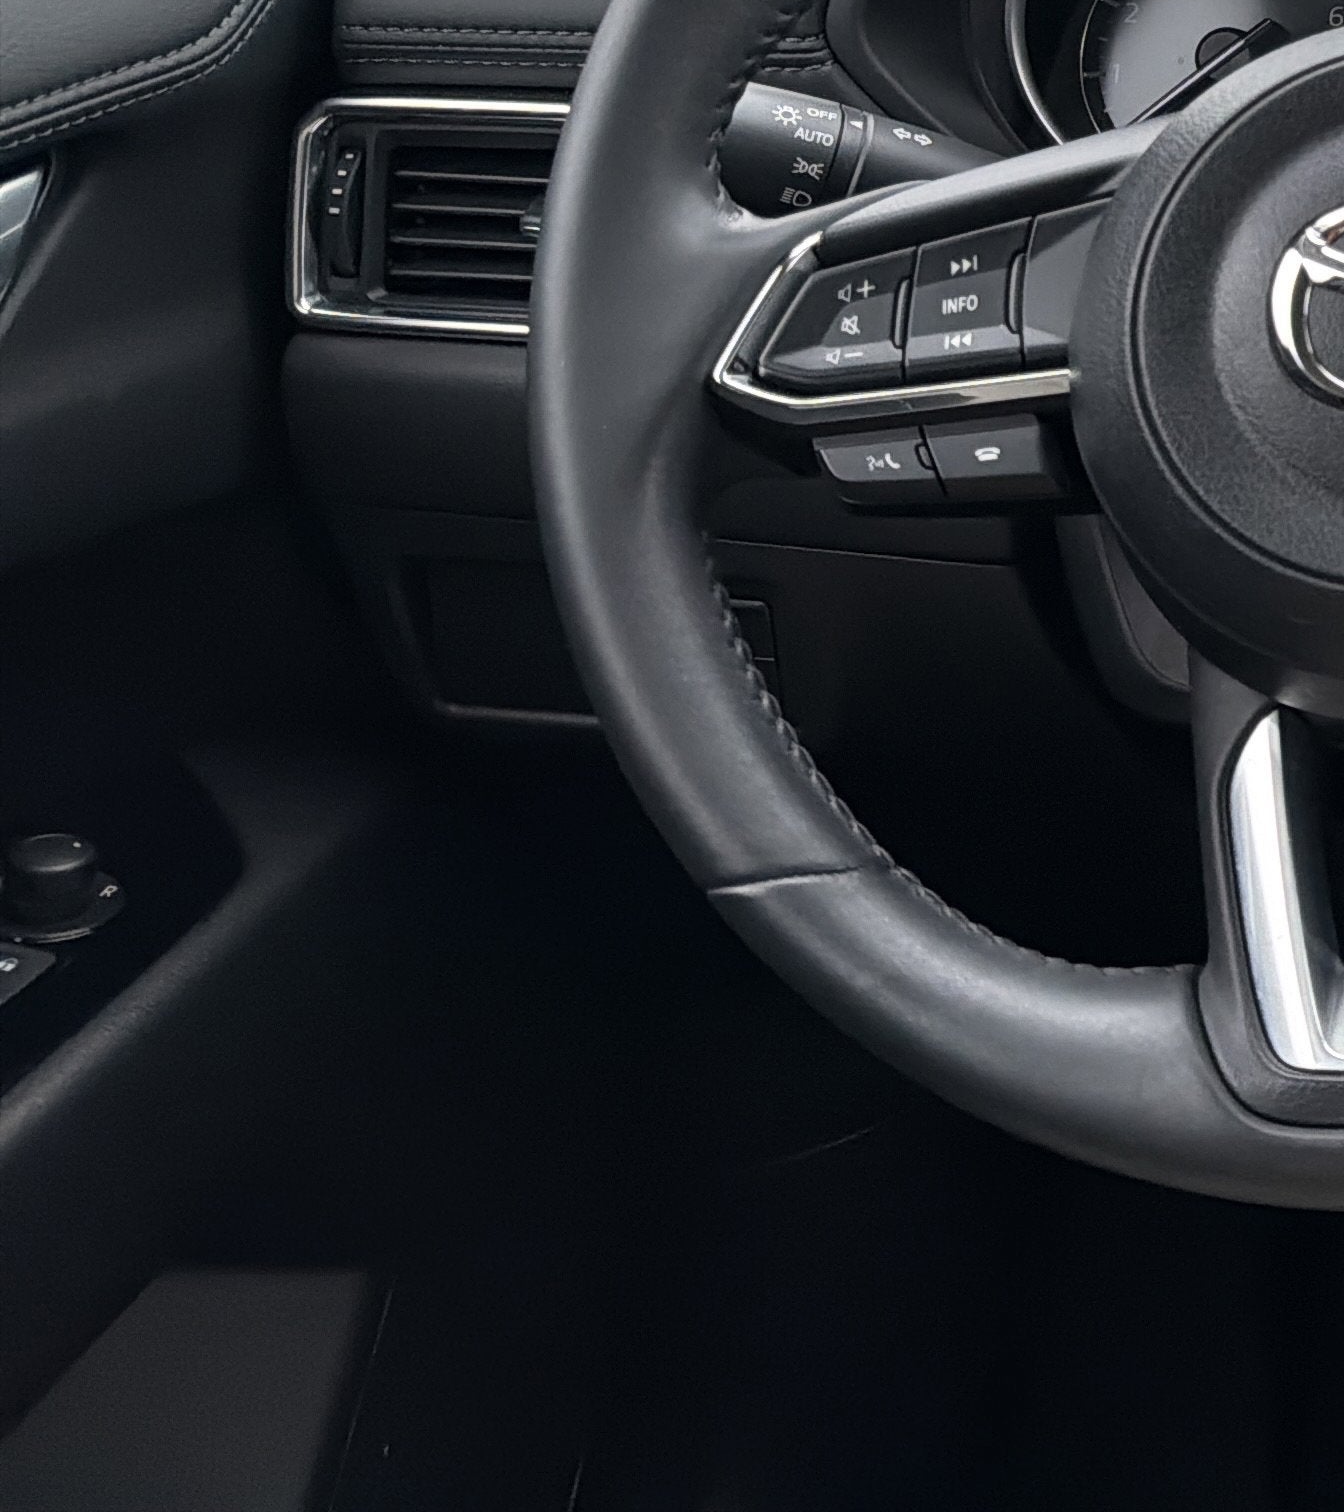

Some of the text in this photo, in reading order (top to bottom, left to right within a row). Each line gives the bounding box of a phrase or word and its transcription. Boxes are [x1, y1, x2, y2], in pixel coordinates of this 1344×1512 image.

[1123, 2, 1139, 24] 2
[1329, 6, 1344, 27] 6
[806, 108, 838, 122] OFF
[794, 126, 835, 148] AUTO
[942, 294, 979, 316] INFO
[98, 884, 119, 897] R
